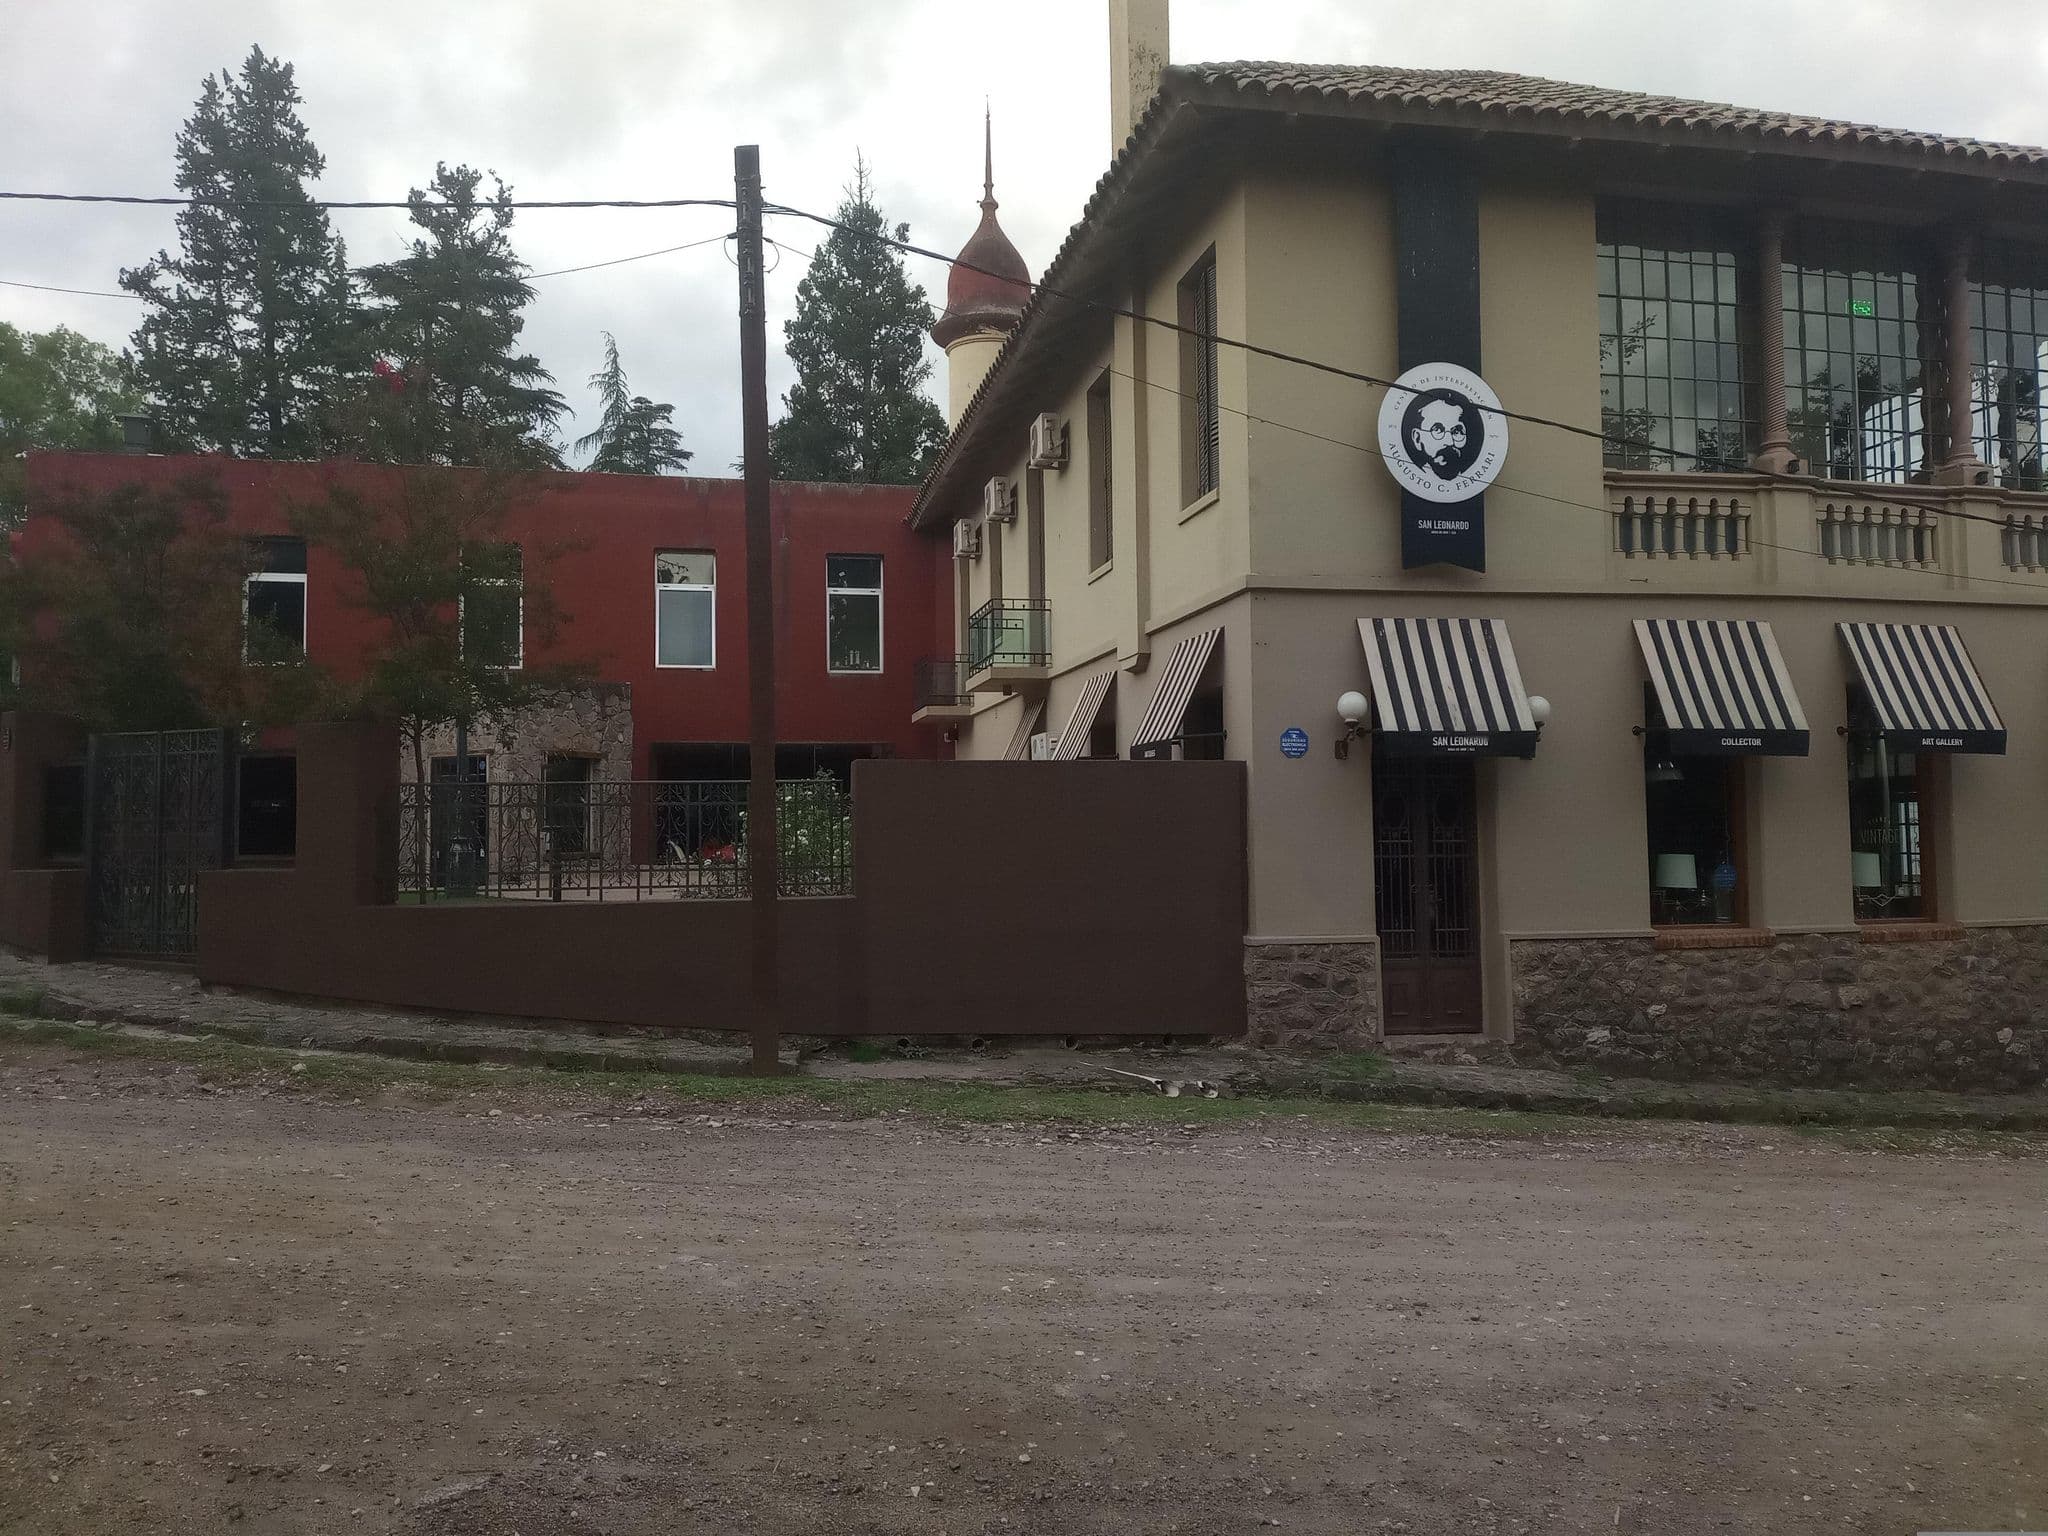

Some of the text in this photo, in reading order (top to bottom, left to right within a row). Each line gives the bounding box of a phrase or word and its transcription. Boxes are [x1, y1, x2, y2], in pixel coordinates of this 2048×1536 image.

[1389, 442, 1496, 493] AUGUSTO C. FERRARI
[1418, 519, 1470, 530] SAN LEONARDO
[1432, 736, 1489, 746] SAN LEONARDO
[1721, 738, 1762, 747] COLLECTOR
[1921, 737, 1963, 747] ART GALLERY
